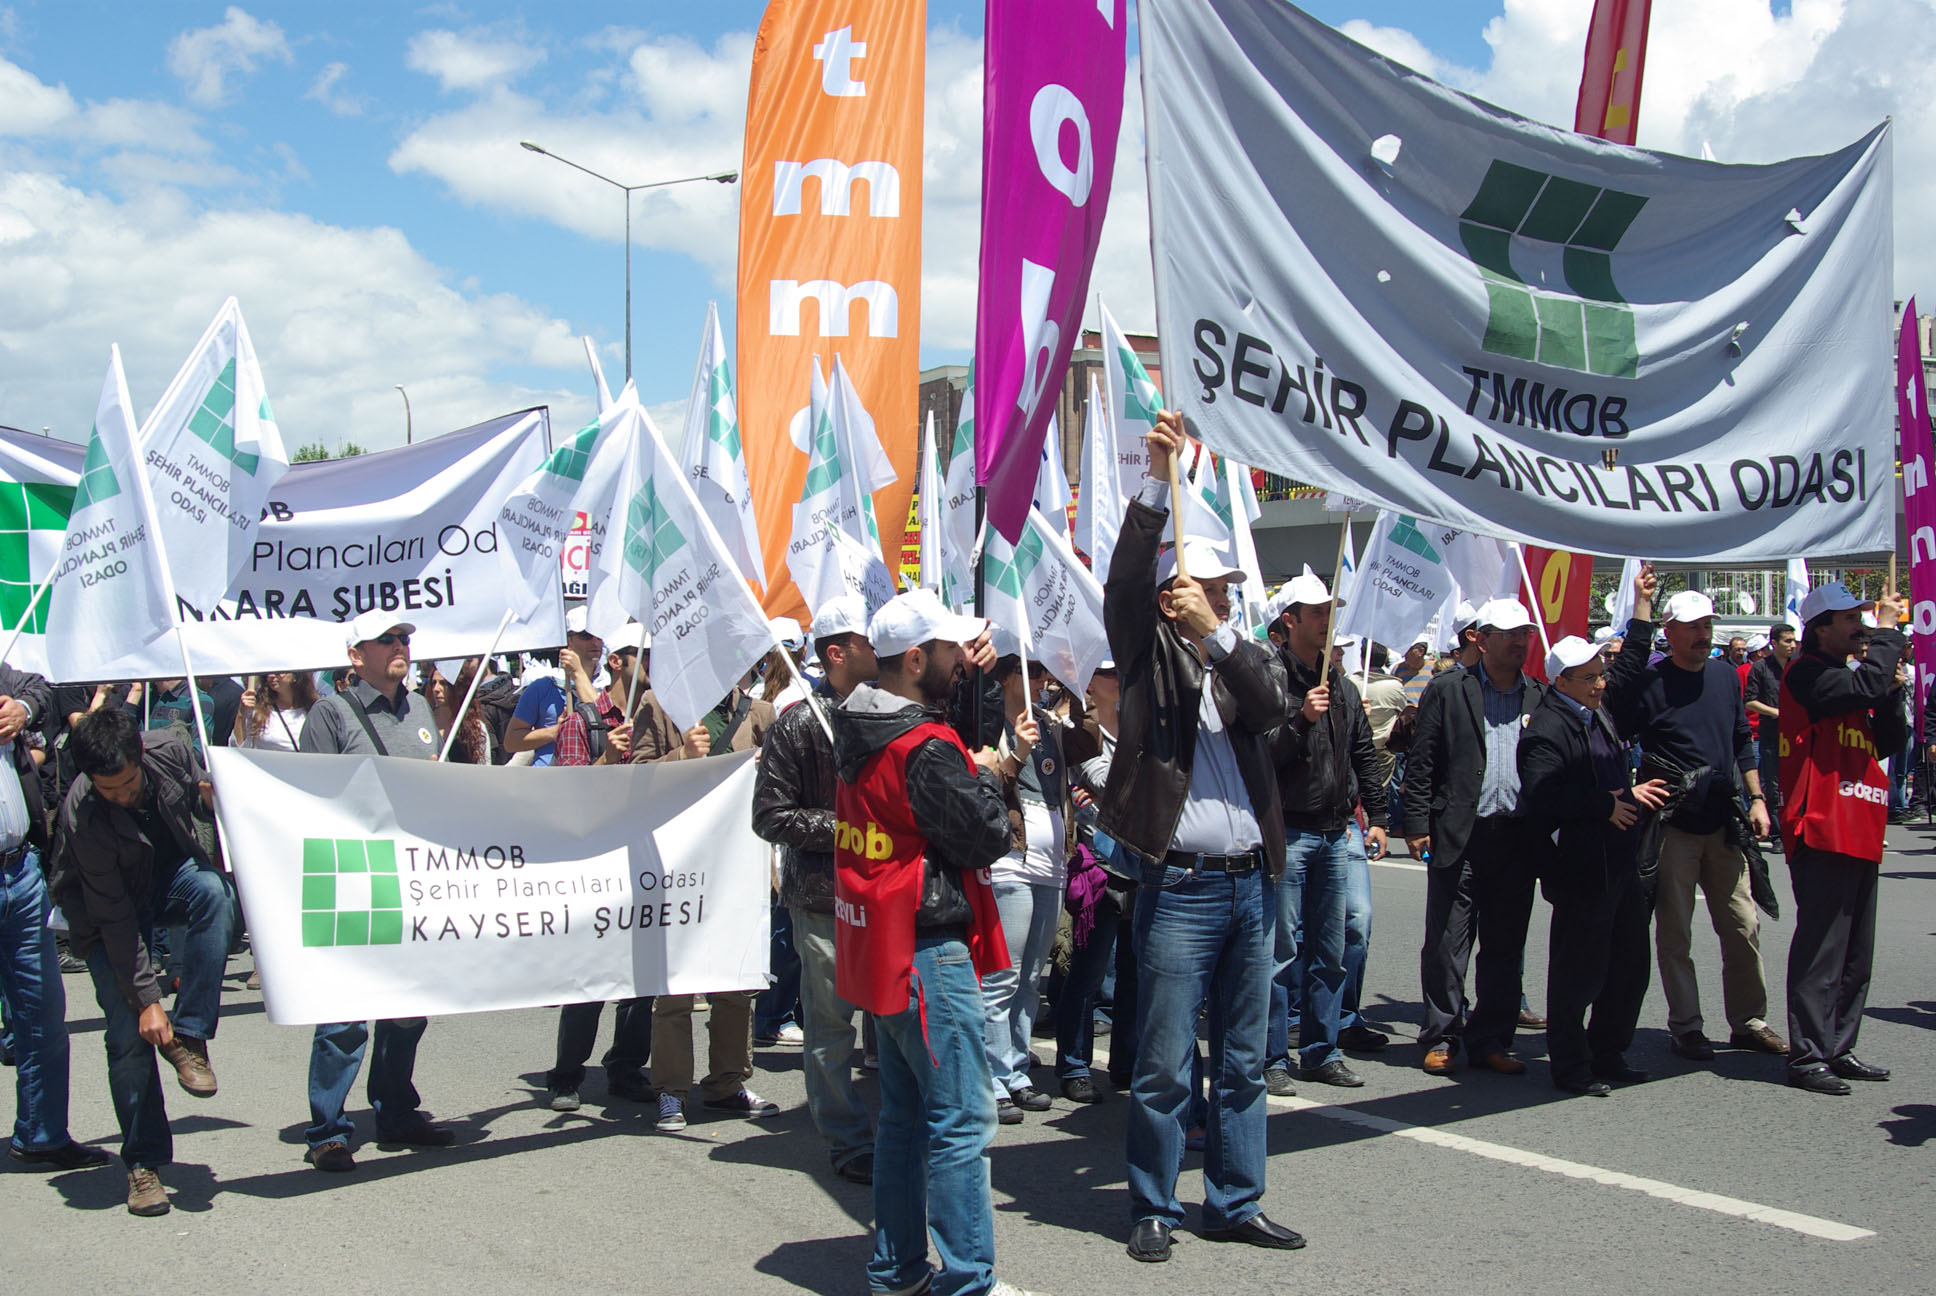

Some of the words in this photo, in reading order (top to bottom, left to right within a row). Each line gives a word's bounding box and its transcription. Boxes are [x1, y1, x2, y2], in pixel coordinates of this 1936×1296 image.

[1193, 318, 1370, 447] ŞEHİR
[1388, 400, 1720, 512] PLANCILARI
[1730, 449, 1867, 511] ODASI
[1462, 366, 1629, 439] TMMOB
[146, 450, 182, 481] ŞEHİR
[182, 475, 251, 531] PLANCILARI
[185, 453, 231, 493] TMMOB
[170, 491, 207, 524] ODASI
[252, 534, 424, 572] Plancıları
[1386, 554, 1421, 578] TMMOB
[331, 568, 455, 623] ŞUBESİ
[1372, 577, 1403, 598] ODASI
[1382, 567, 1435, 600] PLANCILARI
[405, 845, 526, 872] TMMOB
[409, 879, 479, 906] Şehir
[497, 876, 624, 898] Plancıları
[639, 870, 706, 892] Odası
[412, 904, 570, 942] KAYSERİ
[593, 894, 703, 939] ŞUBESİ
